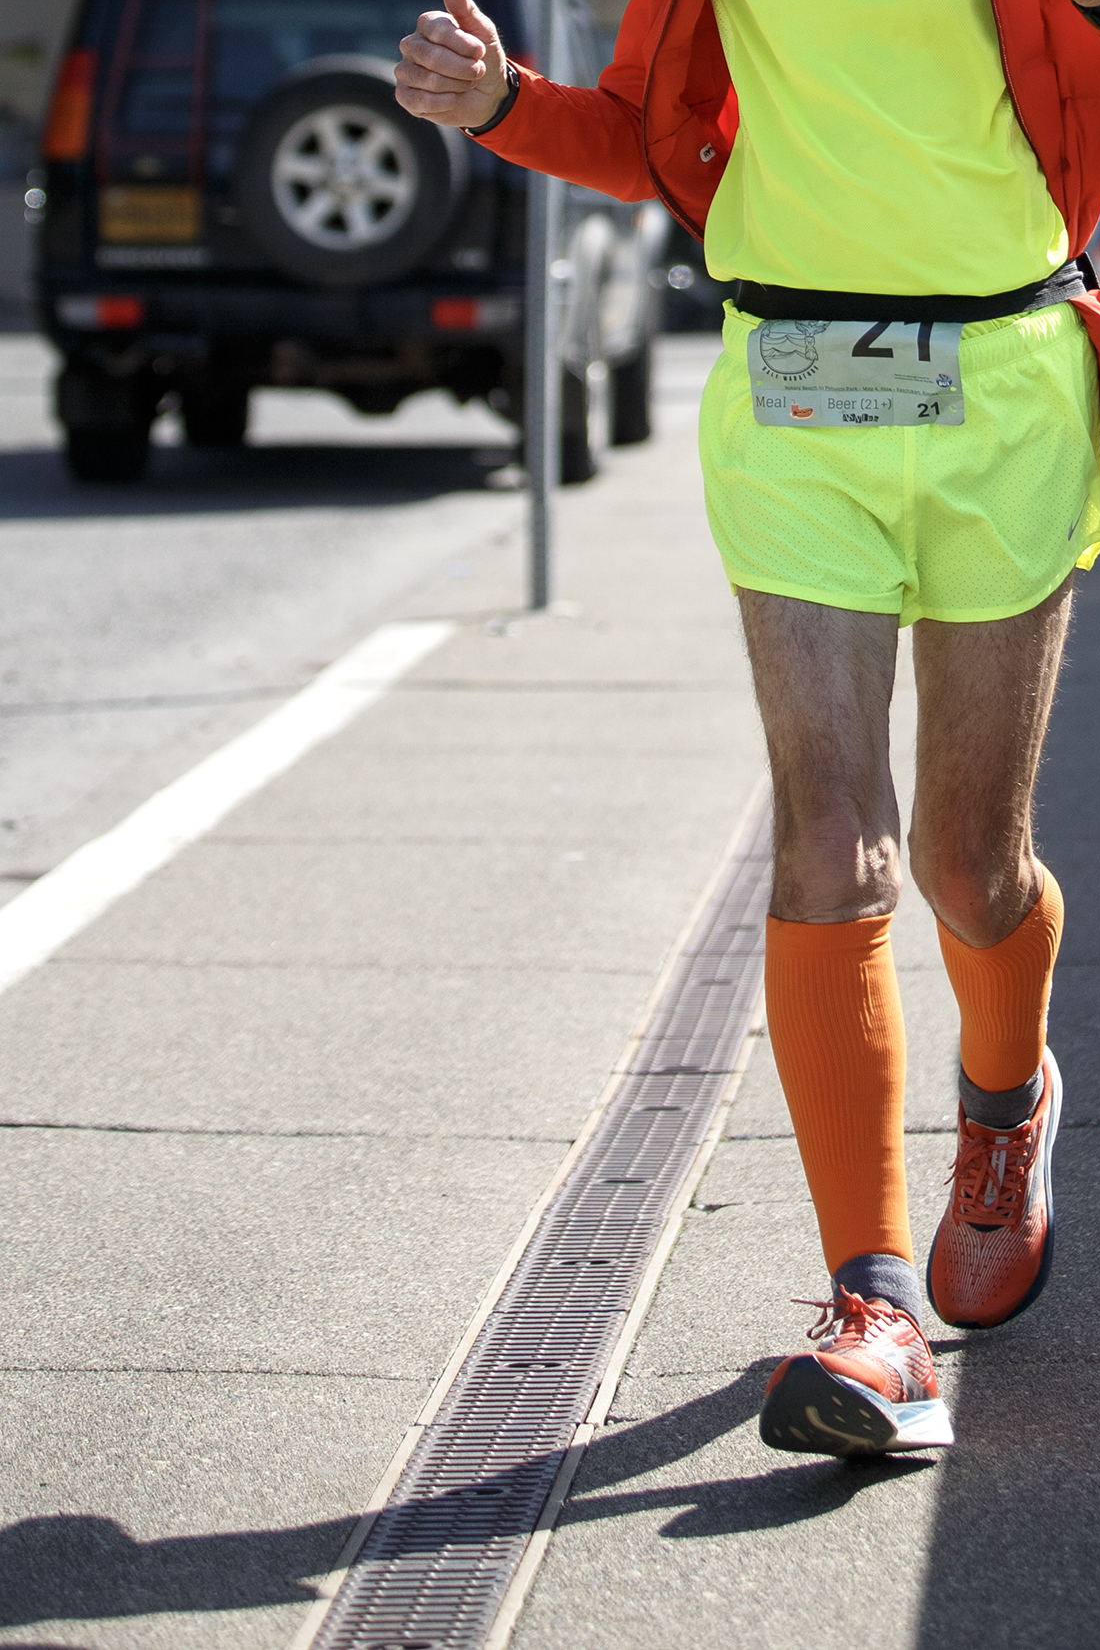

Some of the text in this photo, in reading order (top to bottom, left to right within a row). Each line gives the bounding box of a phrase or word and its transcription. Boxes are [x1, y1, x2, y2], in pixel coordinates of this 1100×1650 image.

[756, 396, 786, 408] Meal
[827, 398, 892, 410] Beer (21+)
[917, 401, 940, 418] 21
